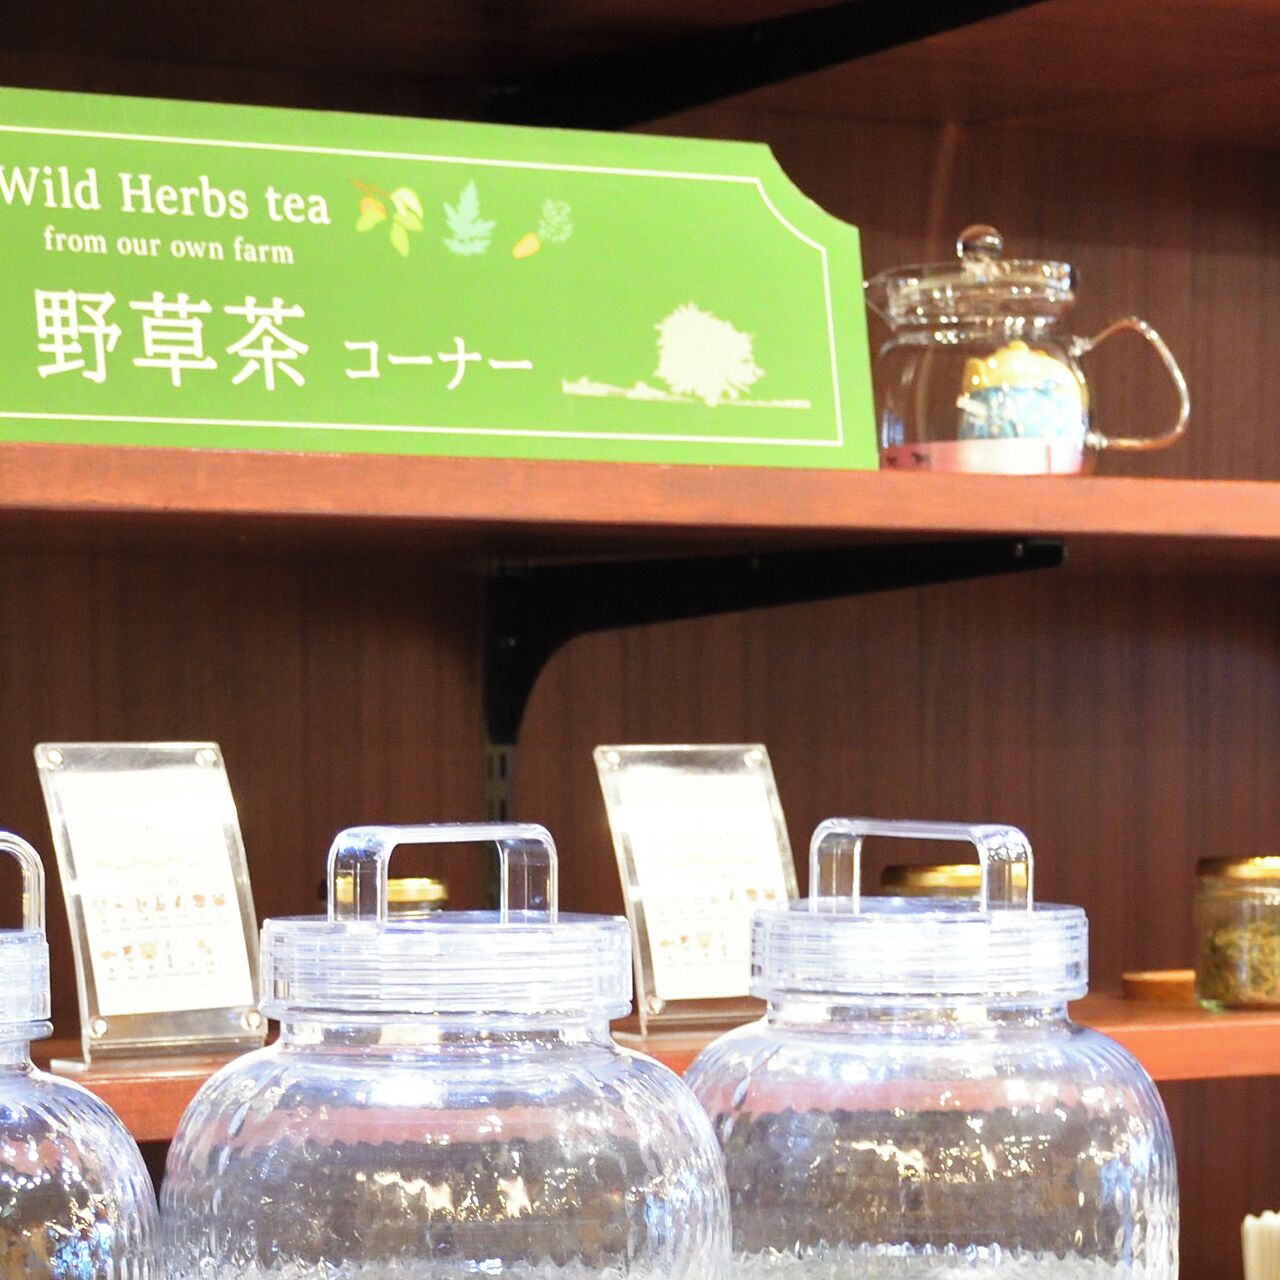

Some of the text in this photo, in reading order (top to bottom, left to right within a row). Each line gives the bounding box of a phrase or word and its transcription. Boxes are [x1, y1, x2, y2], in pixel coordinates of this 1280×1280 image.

[118, 172, 249, 220] Herbs
[264, 185, 331, 225] tea
[43, 225, 295, 265] from our own farm
[34, 288, 534, 391] 野草茶 コーナー
